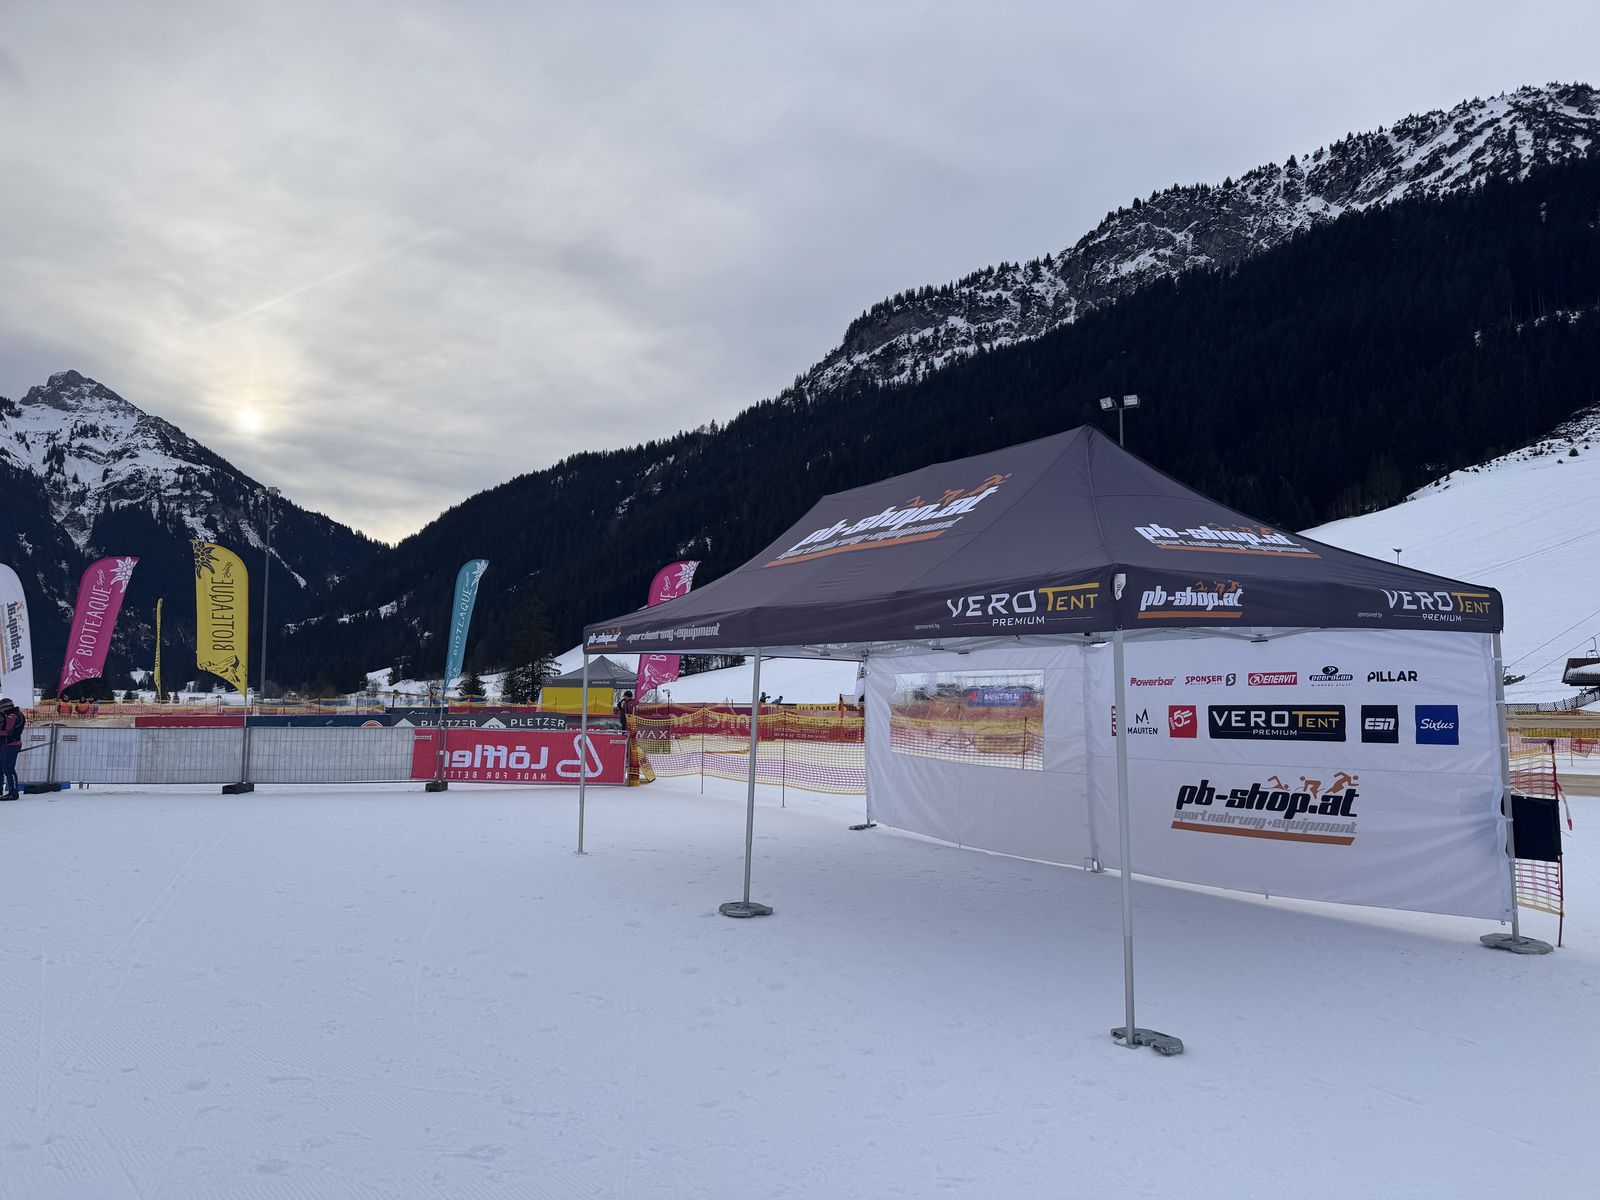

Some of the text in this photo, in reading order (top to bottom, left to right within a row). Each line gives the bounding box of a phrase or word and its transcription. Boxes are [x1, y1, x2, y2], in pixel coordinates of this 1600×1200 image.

[1134, 523, 1300, 546] pb-shop.at
[1139, 585, 1244, 611] pb-shop.at
[76, 584, 112, 657] BIOTEAQUE
[992, 615, 1046, 627] PREMIUM
[1421, 613, 1463, 622] PREMIUM
[1130, 676, 1175, 687] Powerbar
[1185, 675, 1222, 685] SPONSER
[1262, 674, 1297, 684] ENERVIT
[1367, 670, 1418, 683] PILLAR
[510, 717, 565, 728] PLETZER
[1364, 717, 1395, 730] ESN
[1420, 718, 1455, 731] Sixtus
[1127, 726, 1159, 735] MAURTEN
[1175, 779, 1360, 820] pb-shop.at
